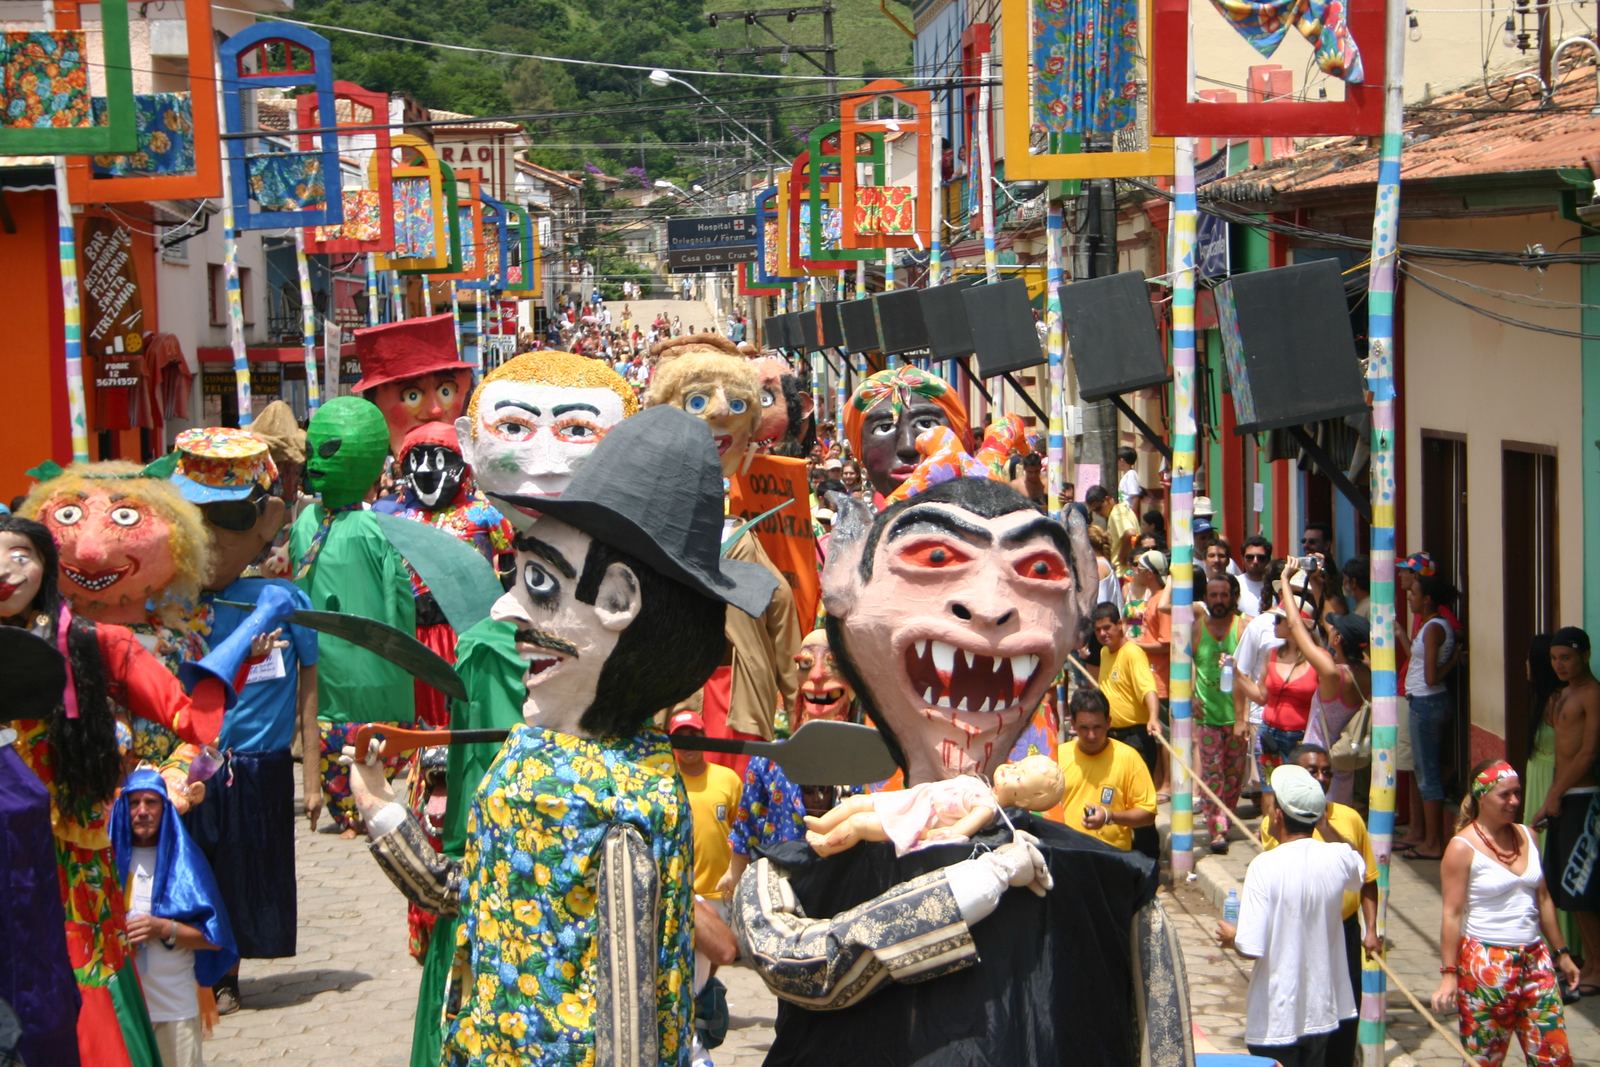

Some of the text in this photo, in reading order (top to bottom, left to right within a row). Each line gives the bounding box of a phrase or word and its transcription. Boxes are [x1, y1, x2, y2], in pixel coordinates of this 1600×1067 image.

[442, 142, 491, 162] RÃO
[697, 223, 731, 231] Hospital
[84, 230, 109, 261] BAR
[672, 237, 711, 245] Delegacia
[681, 255, 700, 263] Casa
[728, 252, 747, 260] Cruz
[90, 250, 129, 300] PIZZARIA
[98, 275, 126, 312] SANTA
[89, 281, 137, 340] TEREZINHA
